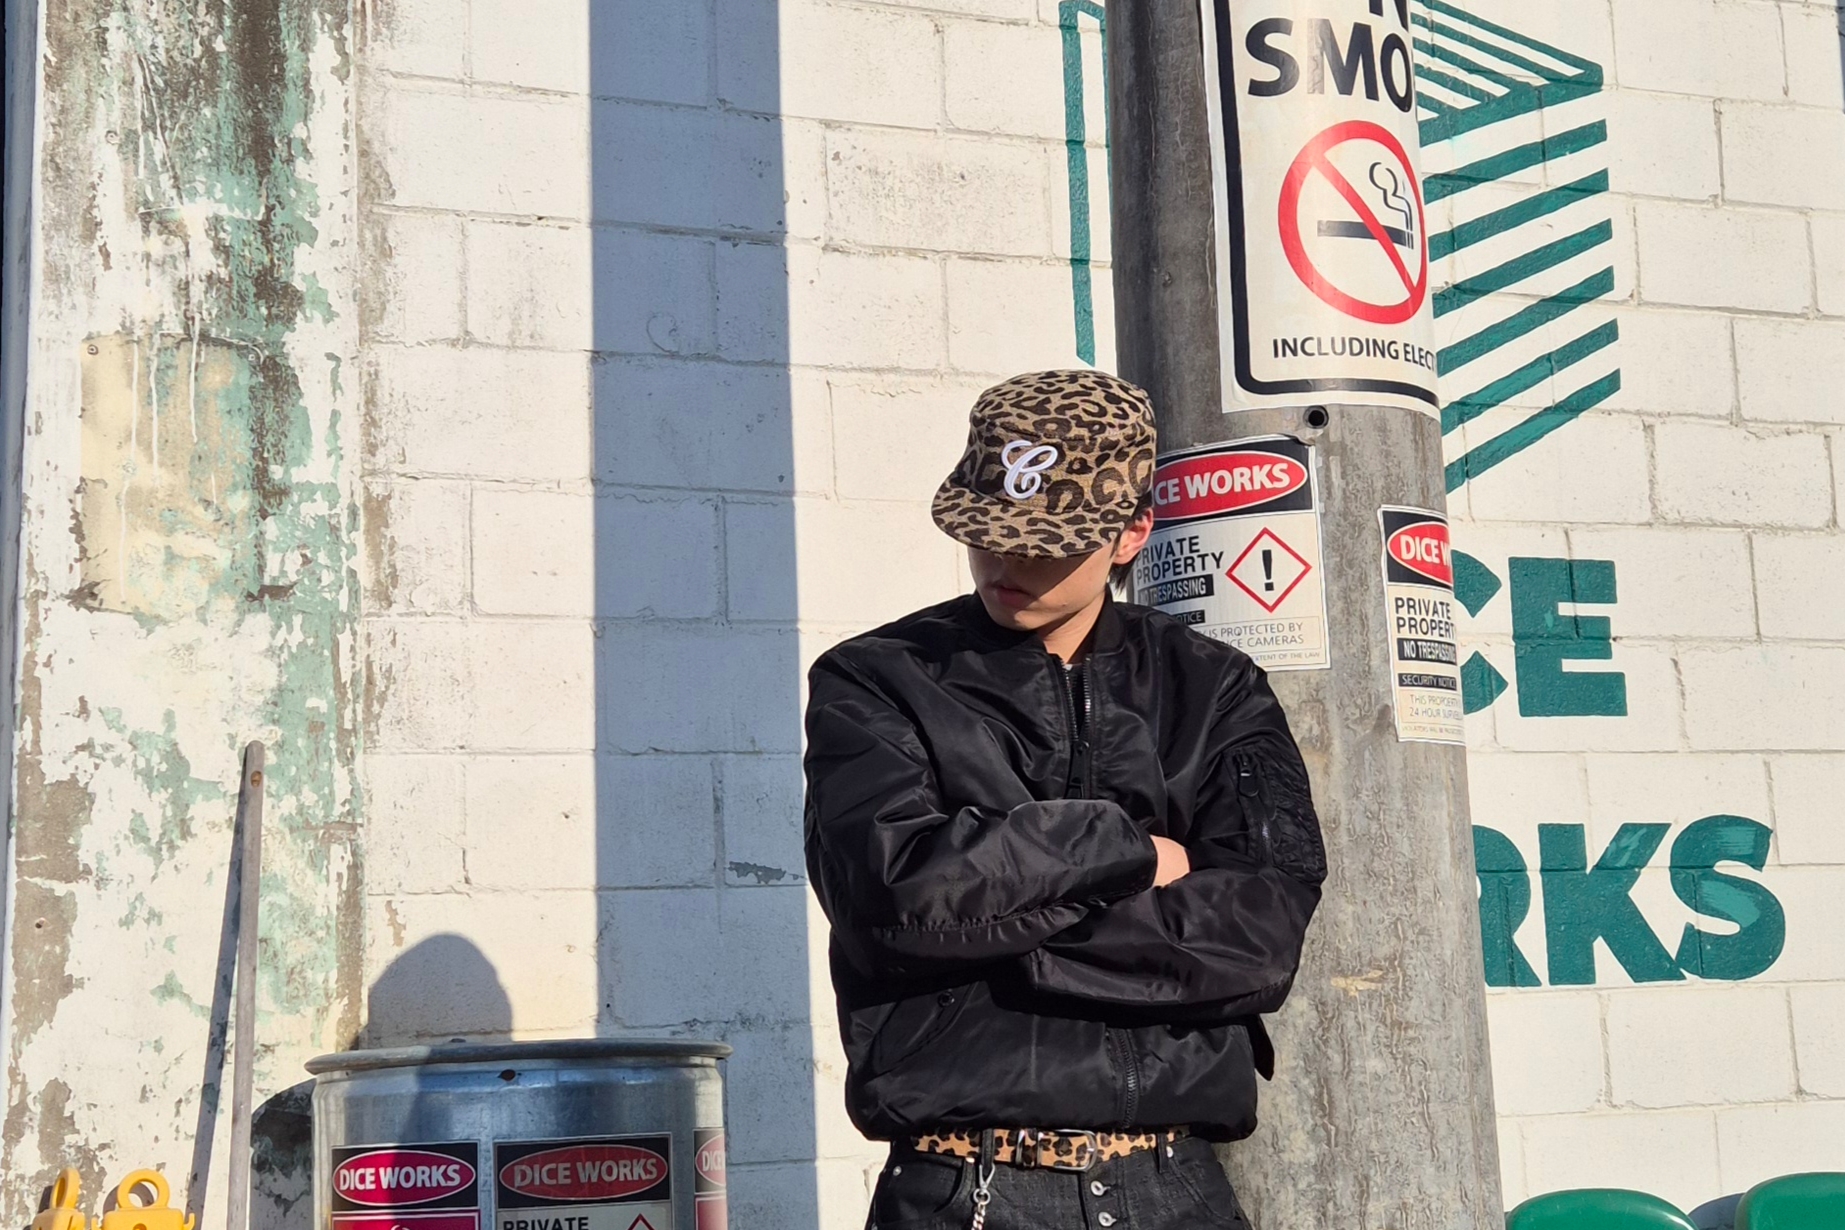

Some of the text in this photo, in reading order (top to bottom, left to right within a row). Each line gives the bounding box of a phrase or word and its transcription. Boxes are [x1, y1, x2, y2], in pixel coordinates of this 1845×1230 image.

[1246, 17, 1412, 113] SMO
[1273, 336, 1435, 372] INCLUDING ELECT
[1154, 463, 1291, 505] CE WORKS
[1400, 534, 1440, 564] DICE
[1137, 551, 1224, 586] PROPERTY
[1150, 577, 1206, 605] TRESPASSING
[1176, 611, 1202, 624] OTICE
[1395, 597, 1451, 620] PRIVATE
[1209, 629, 1218, 639] IS
[1221, 622, 1285, 637] PROTECTED
[1289, 622, 1304, 633] BY
[1396, 617, 1455, 639] PROPERT
[1247, 635, 1304, 648] CAMERAS
[1403, 640, 1416, 658] NO
[1252, 654, 1276, 662] XTENT
[1402, 674, 1437, 687] SECURITY
[1409, 707, 1419, 717] 24
[1471, 814, 1786, 987] RKS
[340, 1164, 461, 1191] DICE WORKS
[514, 1158, 658, 1189] DICE WORKS
